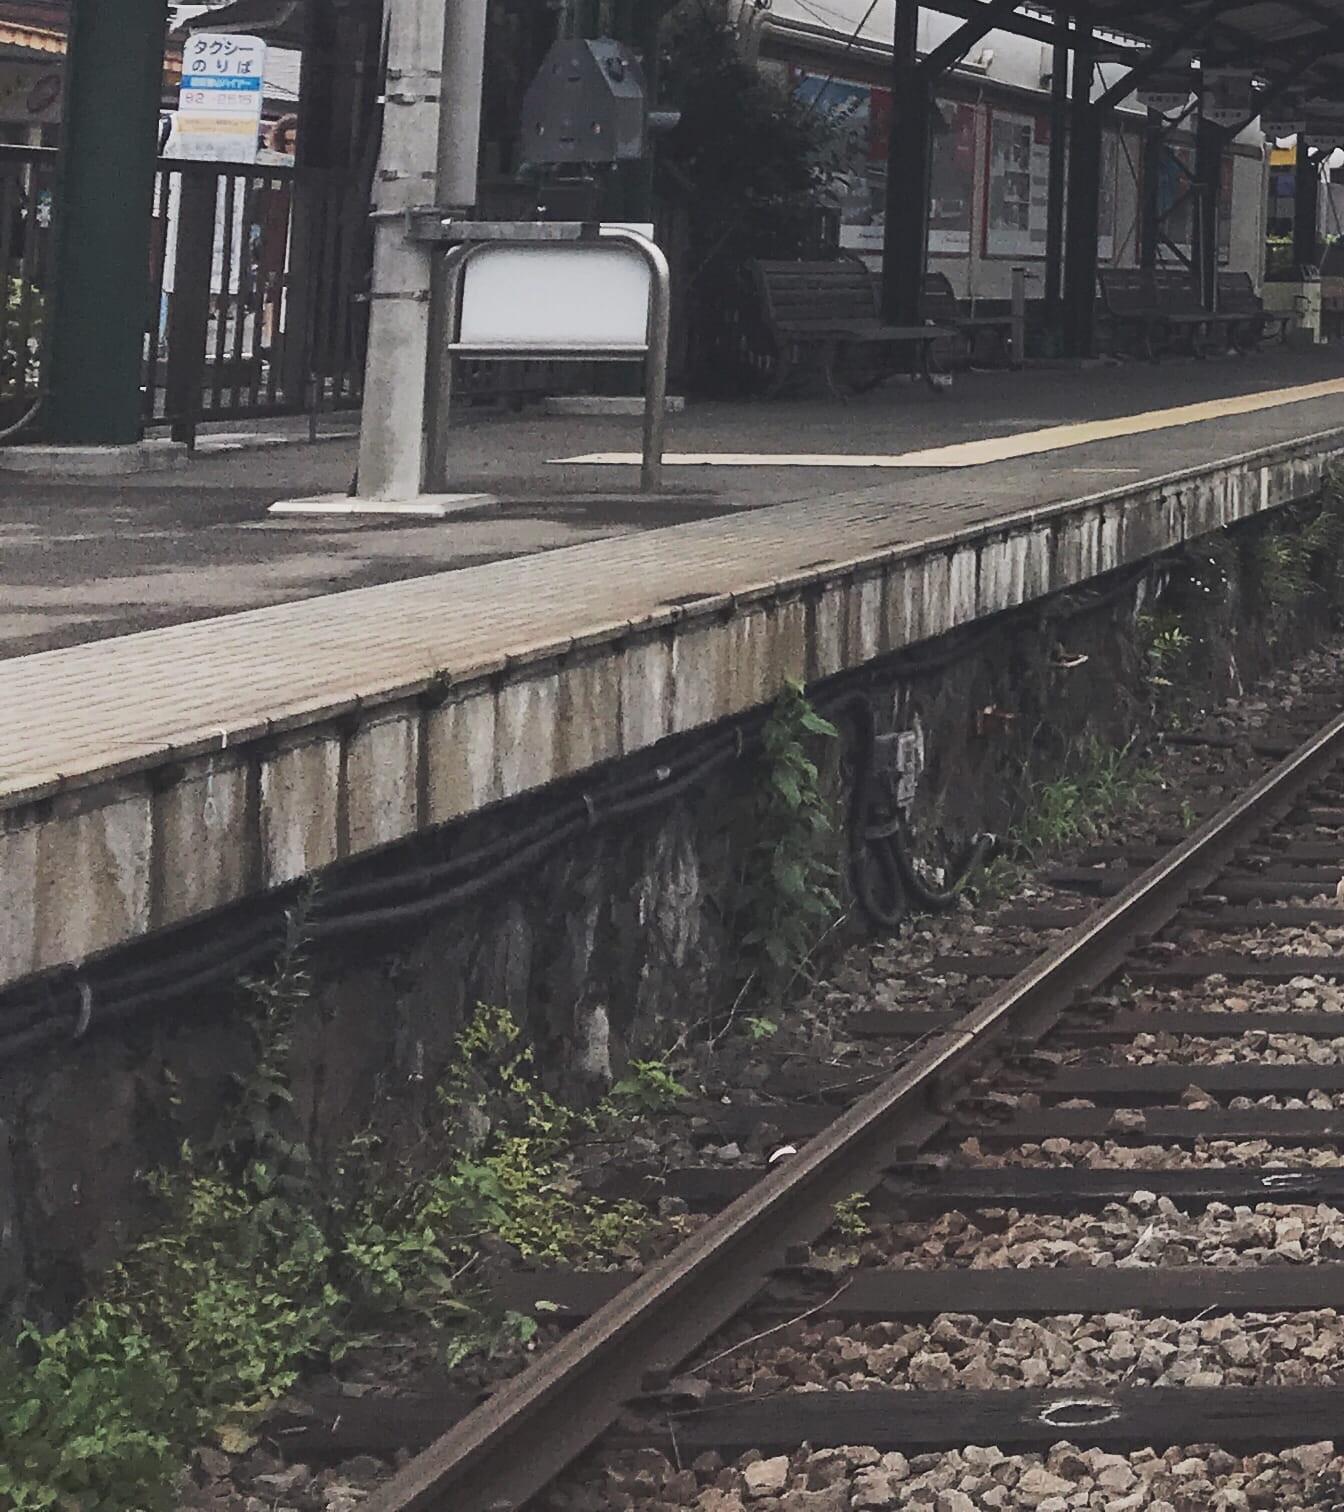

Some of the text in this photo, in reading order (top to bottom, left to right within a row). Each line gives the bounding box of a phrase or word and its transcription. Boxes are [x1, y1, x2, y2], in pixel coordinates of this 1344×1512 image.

[193, 40, 255, 56] タクシー
[192, 59, 254, 74] のりば
